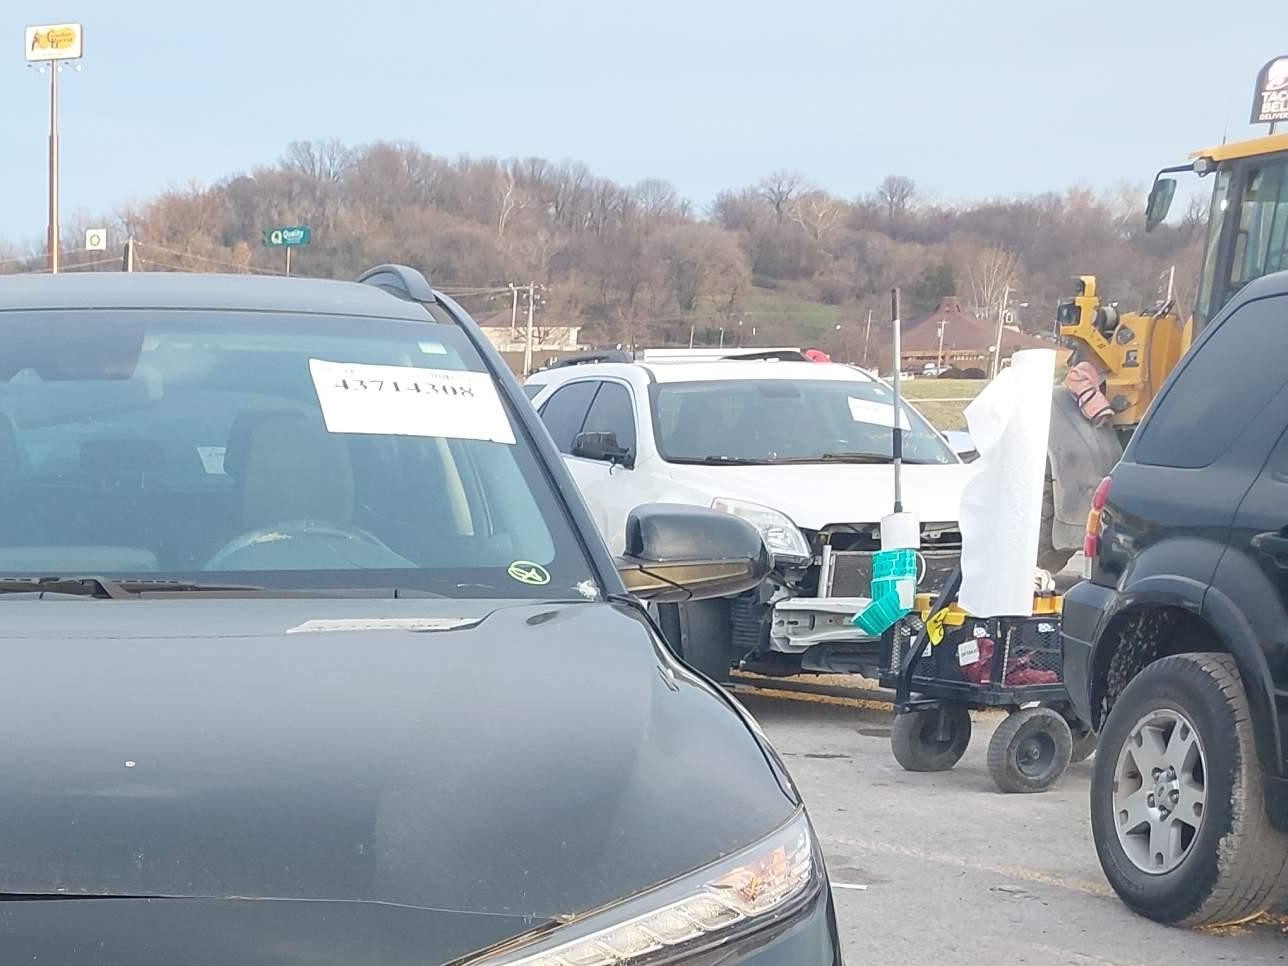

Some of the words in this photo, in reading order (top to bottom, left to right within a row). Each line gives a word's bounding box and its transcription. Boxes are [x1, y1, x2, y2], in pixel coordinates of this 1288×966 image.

[1261, 89, 1288, 103] TAC
[1261, 100, 1288, 113] BEL
[335, 379, 474, 398] 43714308
